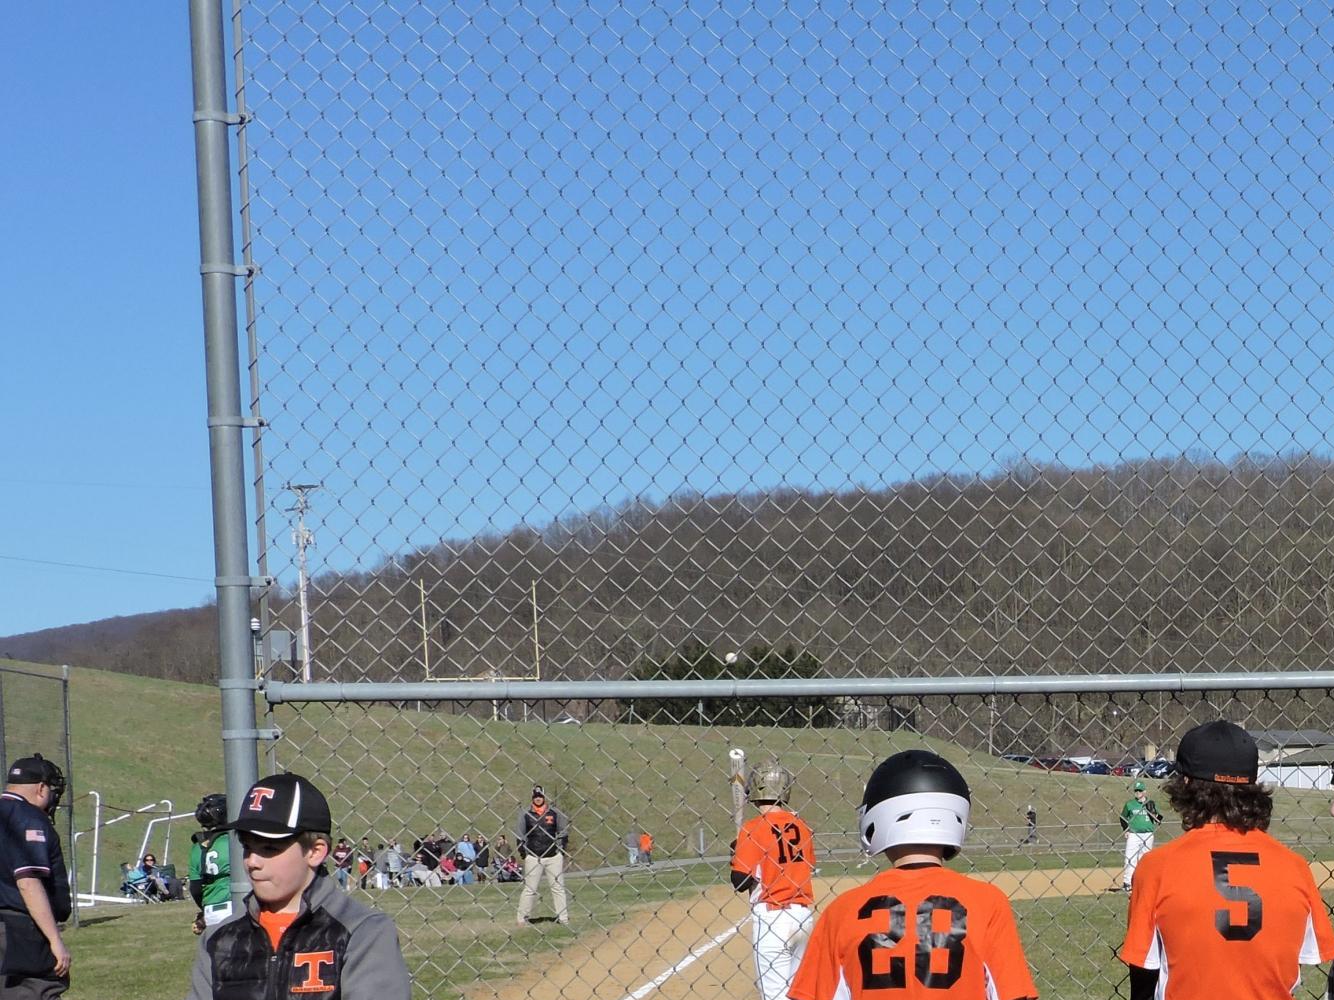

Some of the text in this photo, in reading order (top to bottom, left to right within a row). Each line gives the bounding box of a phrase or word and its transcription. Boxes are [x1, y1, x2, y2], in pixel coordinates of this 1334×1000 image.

[249, 787, 275, 811] T
[771, 822, 805, 864] 12
[1210, 851, 1263, 941] 5
[857, 895, 967, 989] 28
[294, 950, 334, 987] T
